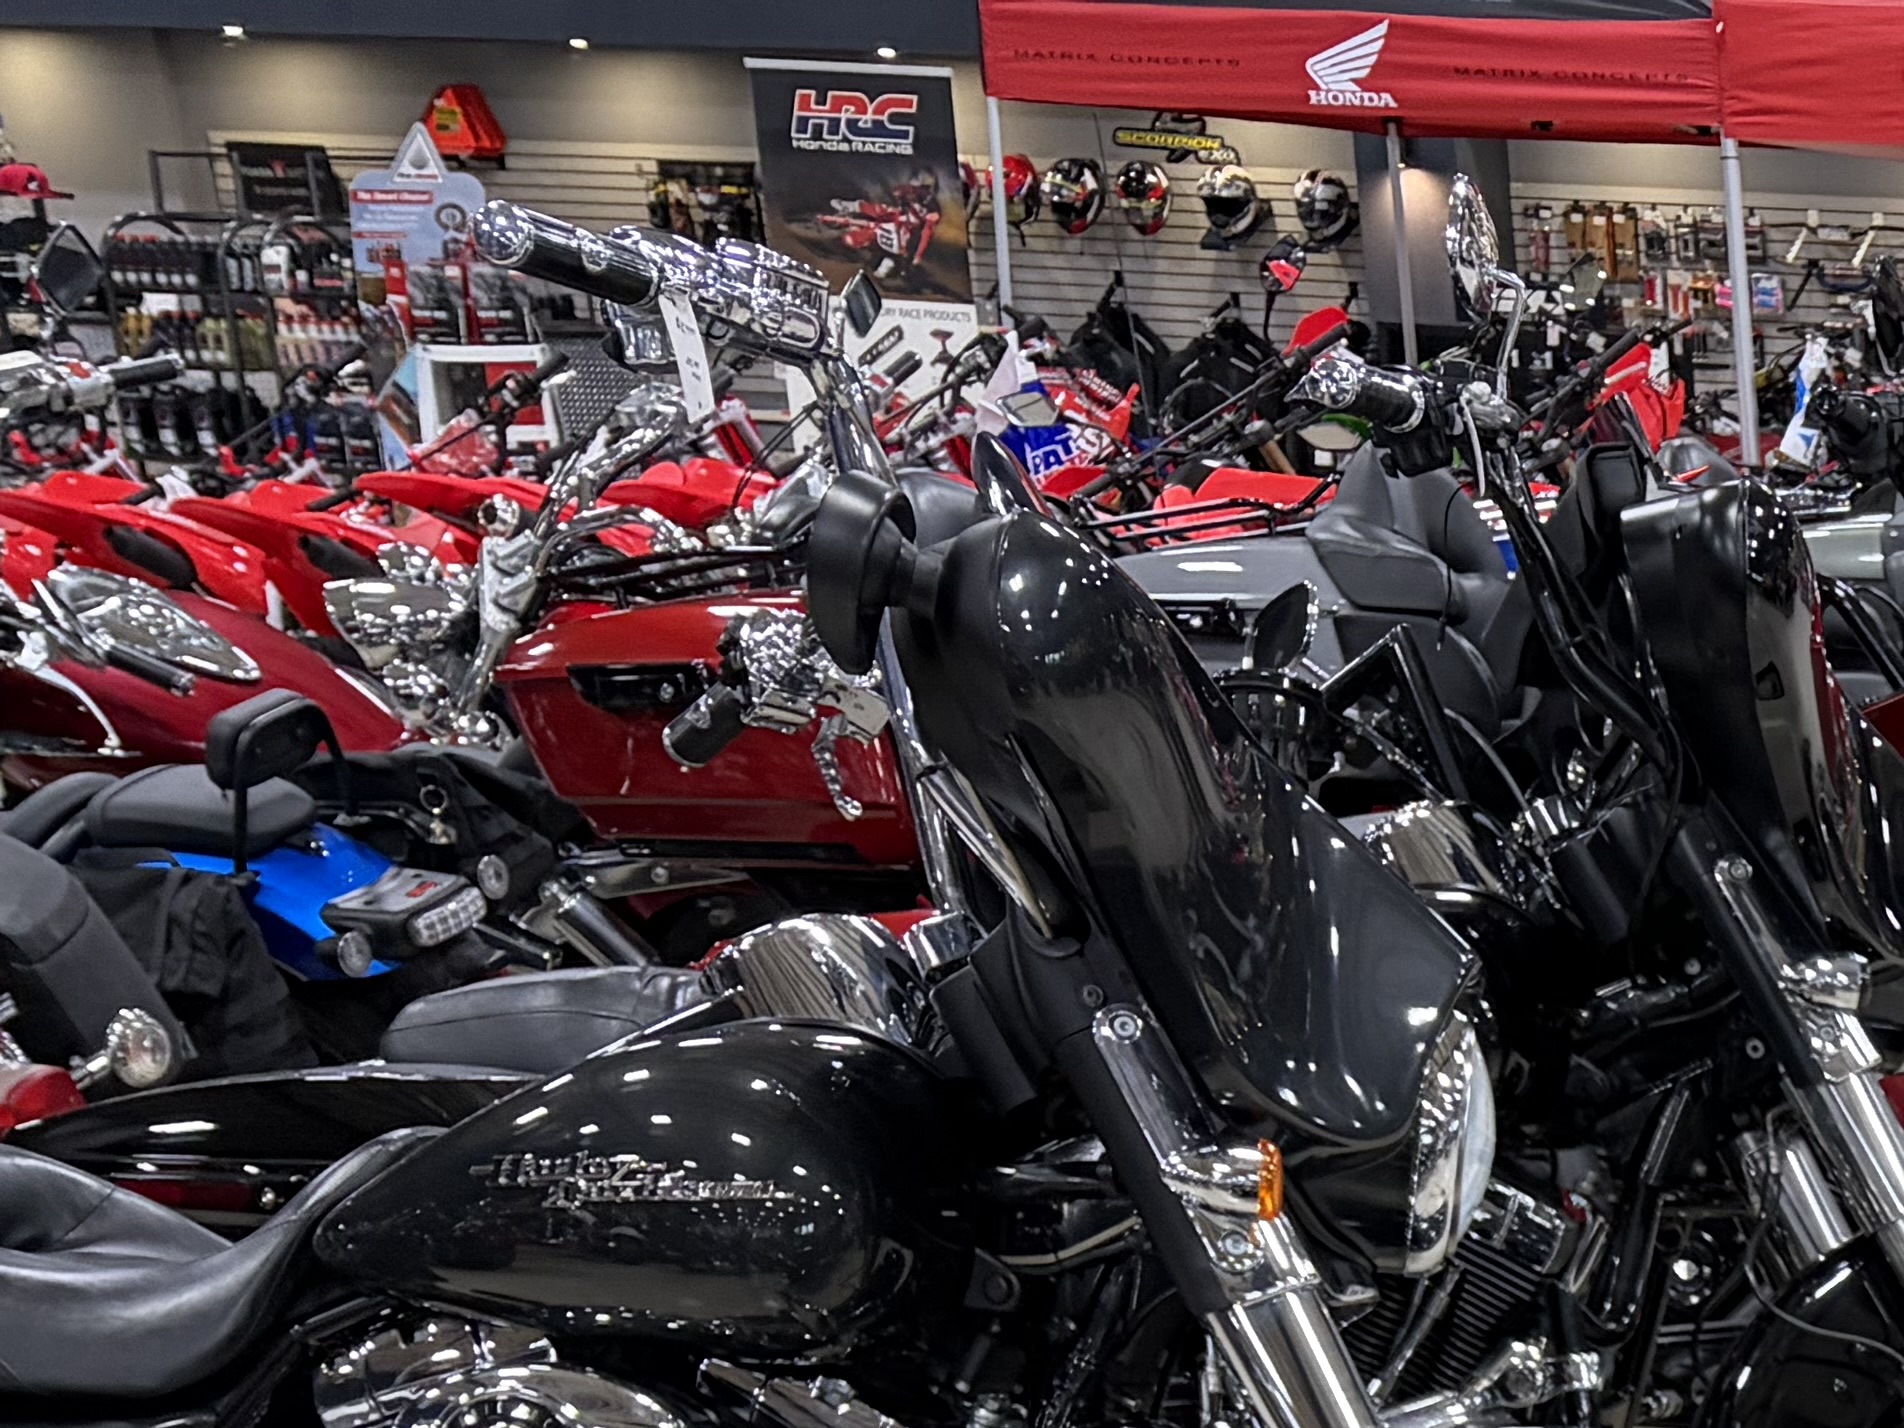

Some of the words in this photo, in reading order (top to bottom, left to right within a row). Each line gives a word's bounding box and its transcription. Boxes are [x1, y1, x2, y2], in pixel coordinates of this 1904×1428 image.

[1012, 48, 1097, 63] MATRIX
[1109, 53, 1241, 68] CONCEPTS
[1453, 66, 1541, 79] MATRIX
[1307, 89, 1398, 108] HONDA
[790, 89, 918, 143] HRC
[791, 138, 850, 152] Honda
[851, 142, 914, 156] RACING
[1116, 130, 1221, 150] SCORPION
